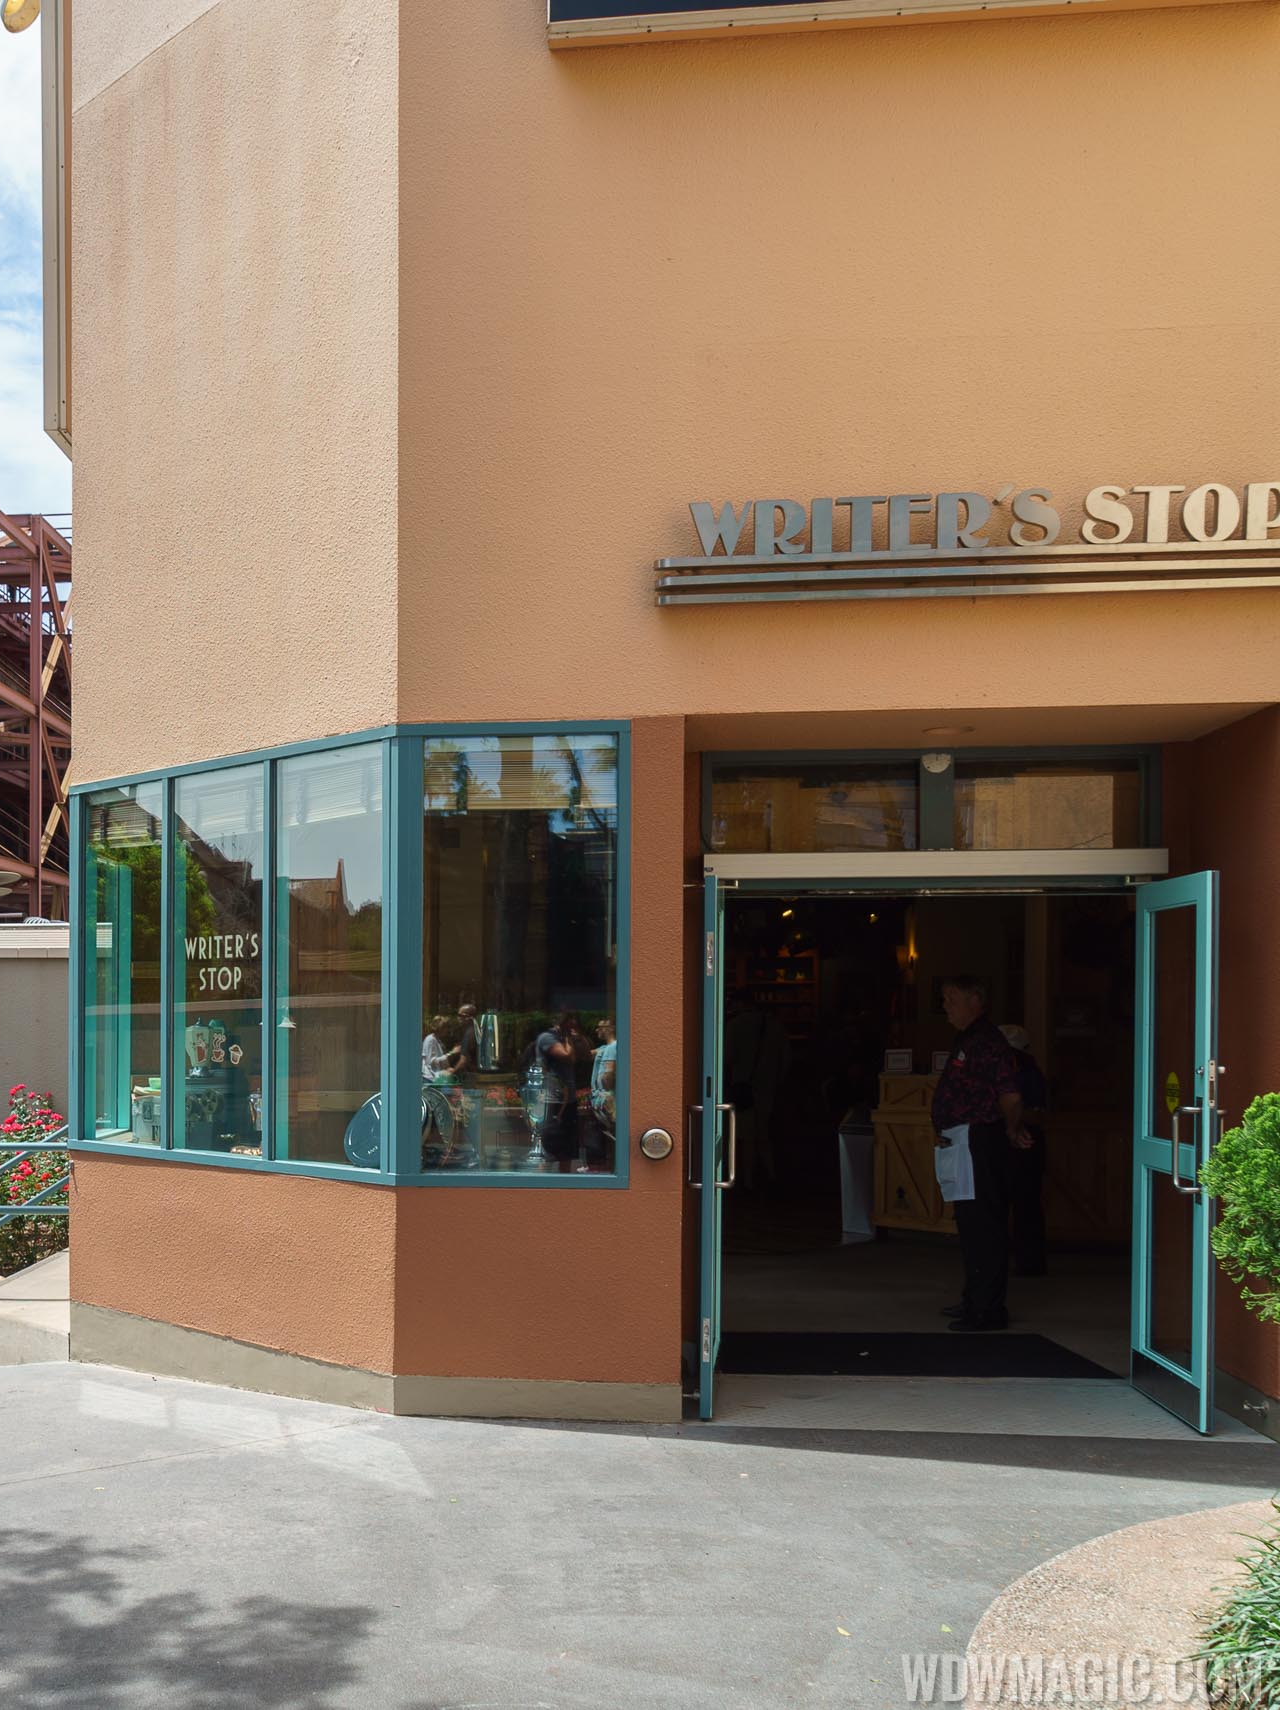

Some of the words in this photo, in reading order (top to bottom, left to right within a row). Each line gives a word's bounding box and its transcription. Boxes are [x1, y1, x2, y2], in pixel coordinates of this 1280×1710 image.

[689, 483, 1061, 557] WRITER'S
[1081, 482, 1280, 544] STOP
[184, 933, 259, 960] WRITER'S
[199, 966, 242, 991] STOP
